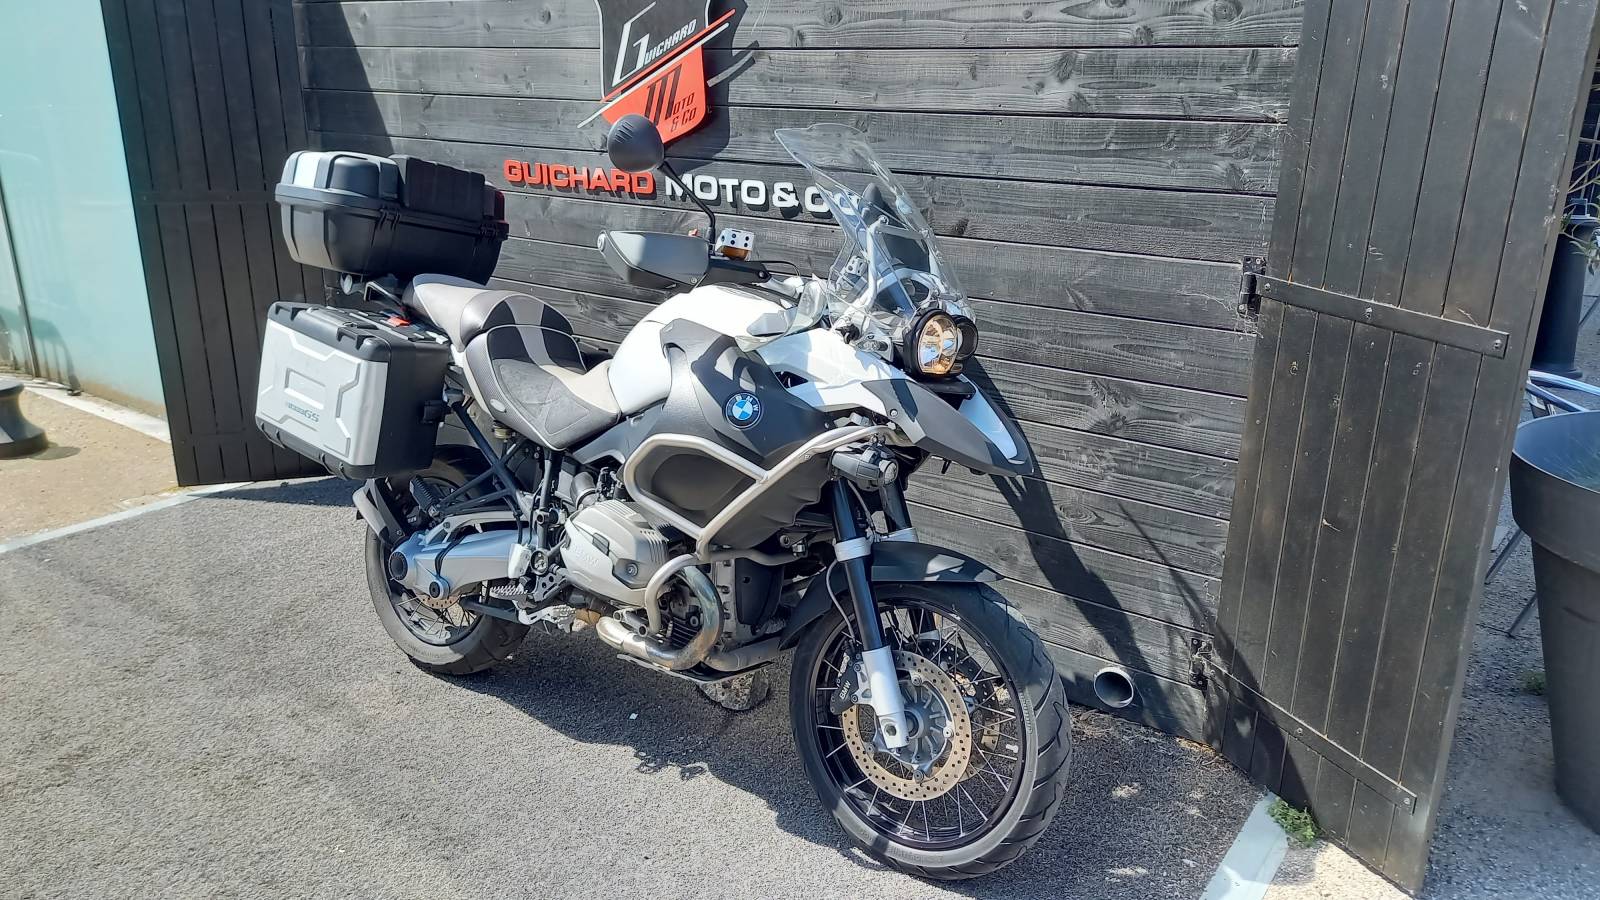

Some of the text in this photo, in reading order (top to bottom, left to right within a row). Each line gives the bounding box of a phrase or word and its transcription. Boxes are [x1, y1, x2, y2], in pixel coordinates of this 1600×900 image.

[612, 1, 697, 87] GUICHARD
[644, 64, 695, 126] MOTO
[681, 107, 697, 126] CO
[503, 159, 656, 195] GUICHARD
[664, 173, 766, 206] MOTO
[839, 680, 851, 700] BMW
